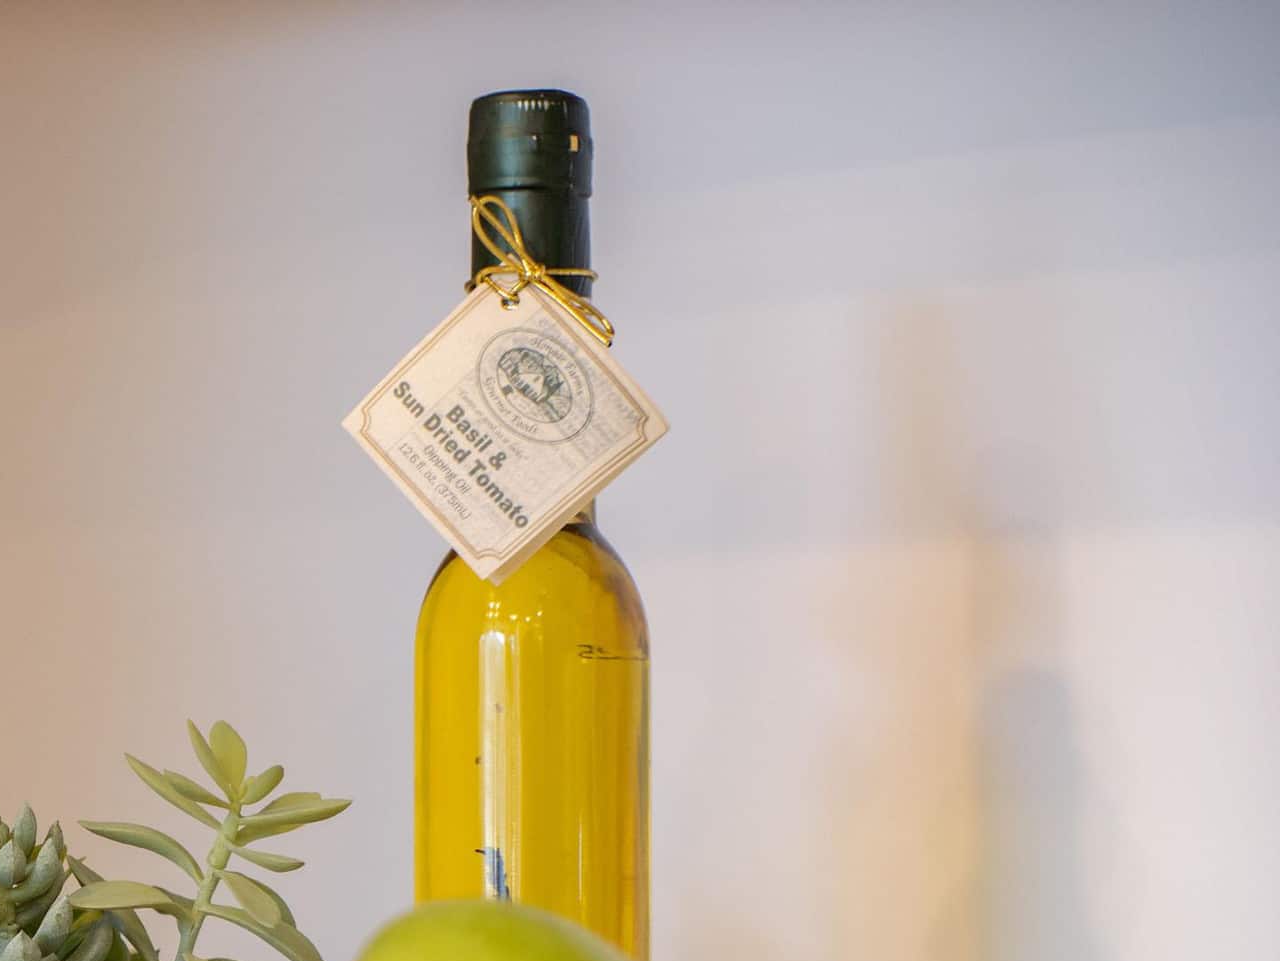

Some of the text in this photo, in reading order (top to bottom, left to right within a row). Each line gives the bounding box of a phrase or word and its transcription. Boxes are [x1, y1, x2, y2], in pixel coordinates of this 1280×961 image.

[393, 381, 425, 418] Sun
[423, 413, 470, 464] Dried
[468, 460, 529, 528] Tomato
[424, 444, 471, 495] Dipping Oil
[446, 405, 492, 453] Basil
[488, 451, 507, 470] &
